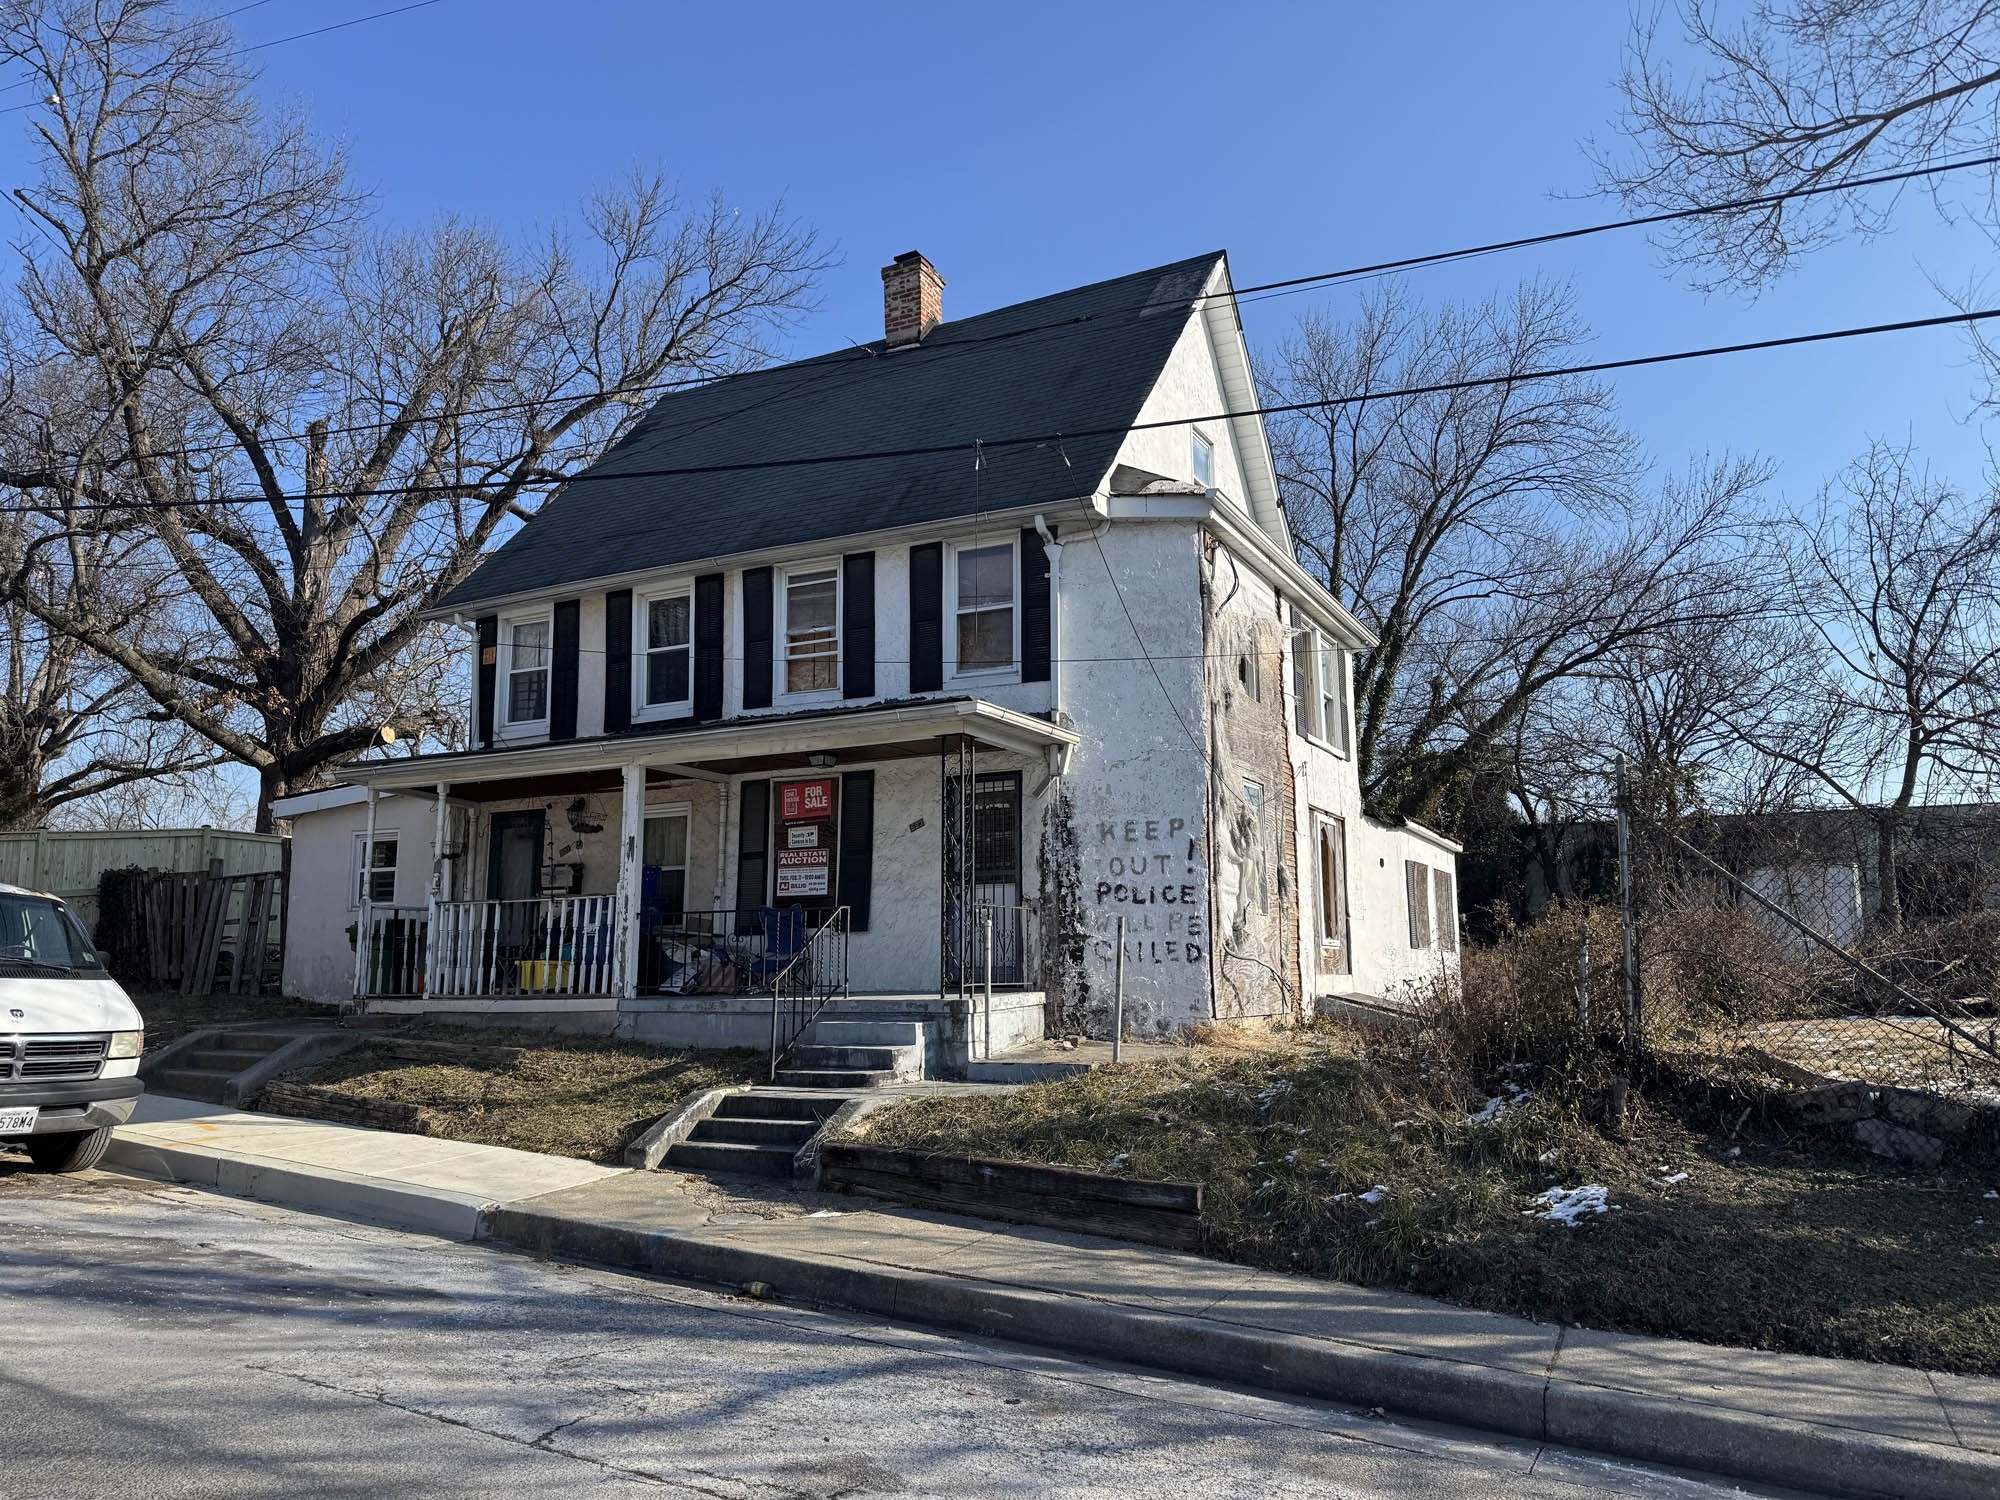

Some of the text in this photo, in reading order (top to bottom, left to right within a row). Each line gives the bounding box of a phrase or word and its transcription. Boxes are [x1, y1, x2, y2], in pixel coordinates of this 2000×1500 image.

[804, 786, 822, 797] FOR
[804, 796, 828, 809] SALE
[1097, 817, 1184, 842] KEEP
[780, 856, 827, 865] AUCTION
[1096, 881, 1195, 905] POLICE
[1095, 911, 1200, 936] WLL BE
